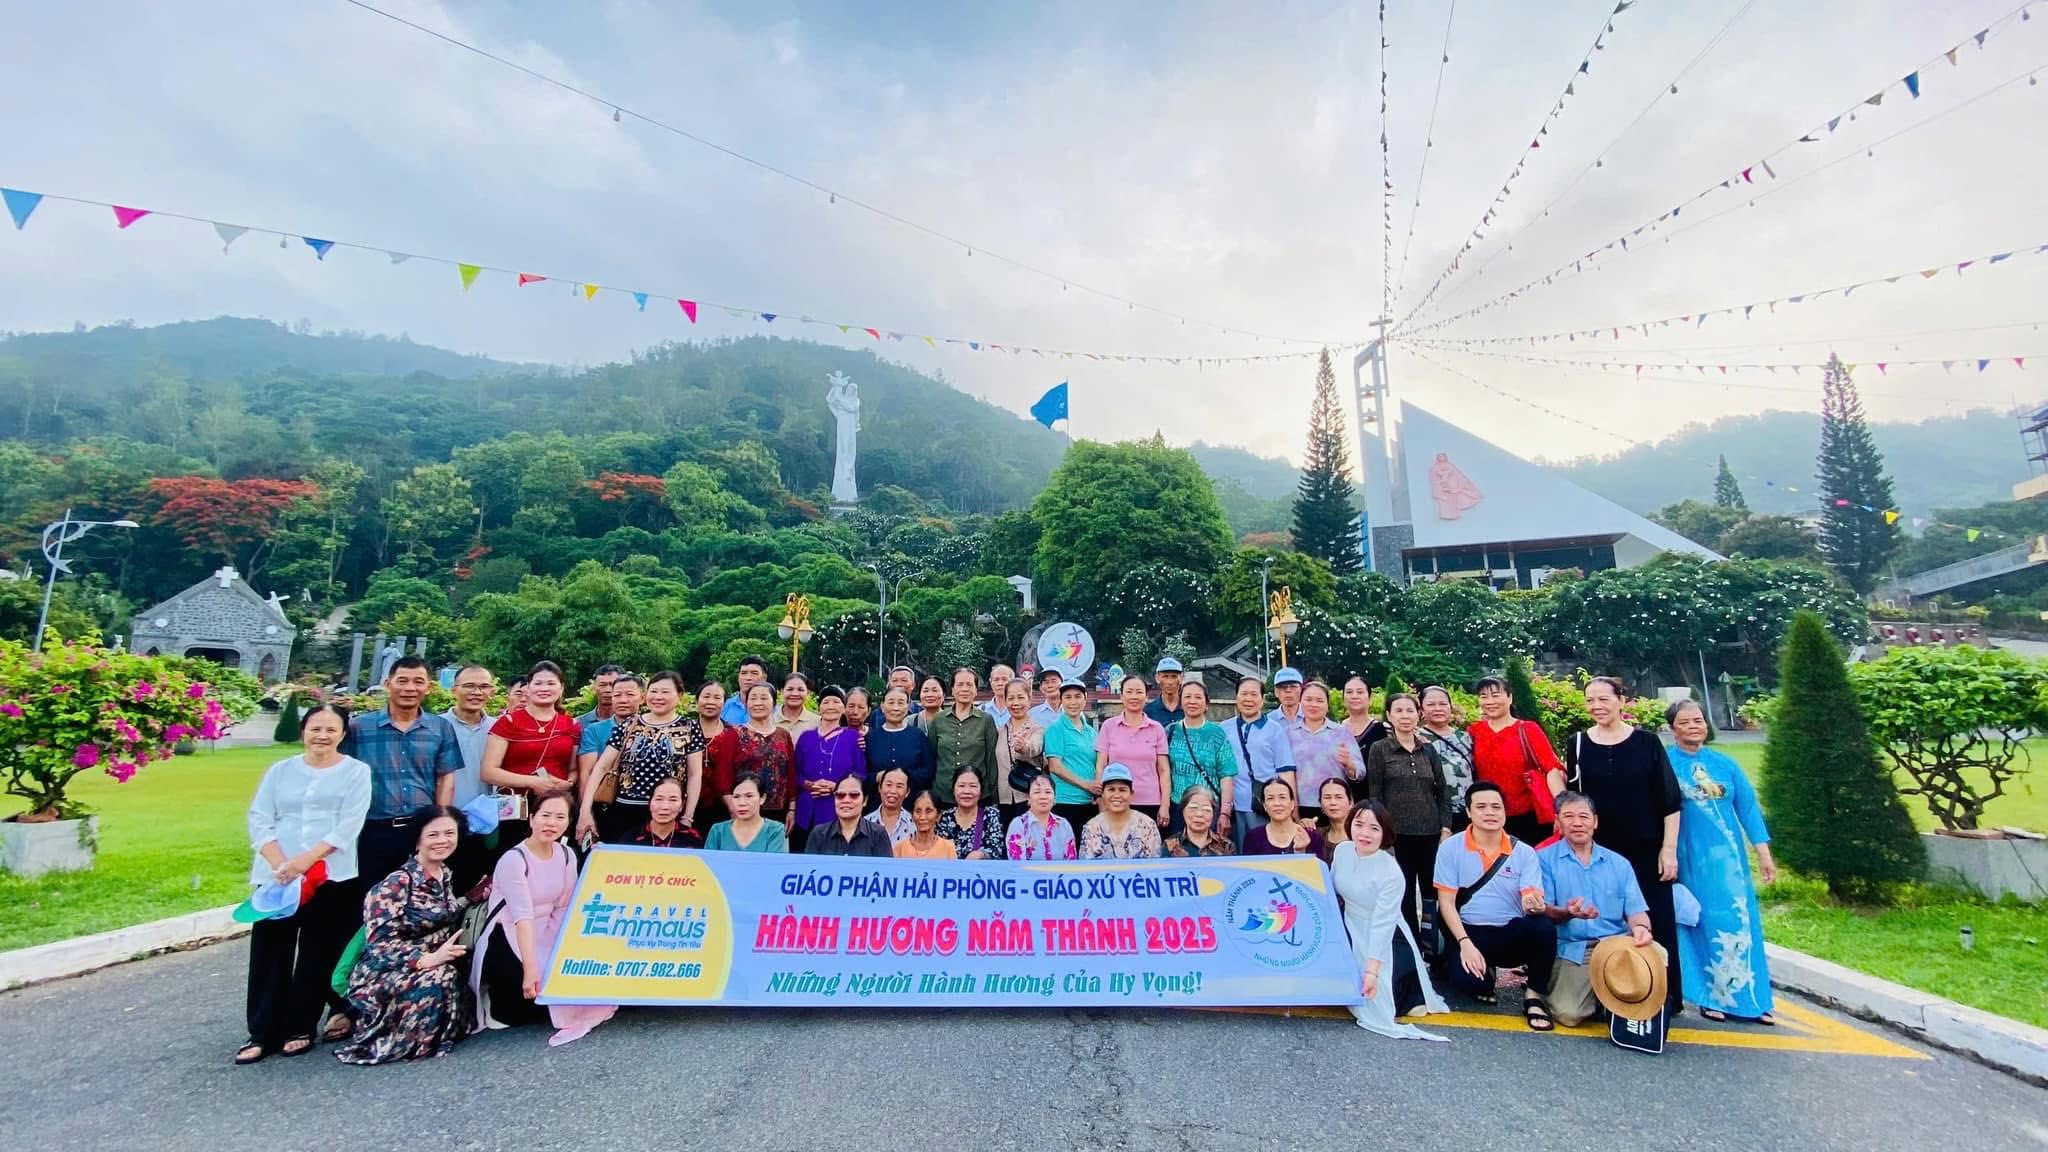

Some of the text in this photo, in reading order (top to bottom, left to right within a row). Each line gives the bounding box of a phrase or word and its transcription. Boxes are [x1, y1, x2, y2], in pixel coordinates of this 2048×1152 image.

[667, 875, 697, 887] CHỨC
[781, 869, 834, 897] GIÁO
[837, 872, 898, 903] PHẬN
[902, 872, 937, 898] HẢI
[942, 874, 1016, 900] PHÒNG
[1033, 873, 1083, 900] GIÁO
[1088, 873, 1118, 899] XỨ
[1119, 873, 1161, 898] YÊN
[1163, 872, 1200, 897] TRÌ
[584, 909, 707, 939] Emmaus
[619, 904, 707, 918] TRAVEL
[753, 904, 1218, 956] HÀNH HƯƠNG NĂM THÁNH 2025
[561, 959, 701, 978] Hotline: 0707.982.666
[766, 968, 1203, 997] Những Người Hành Hương Của Hy Vọng!
